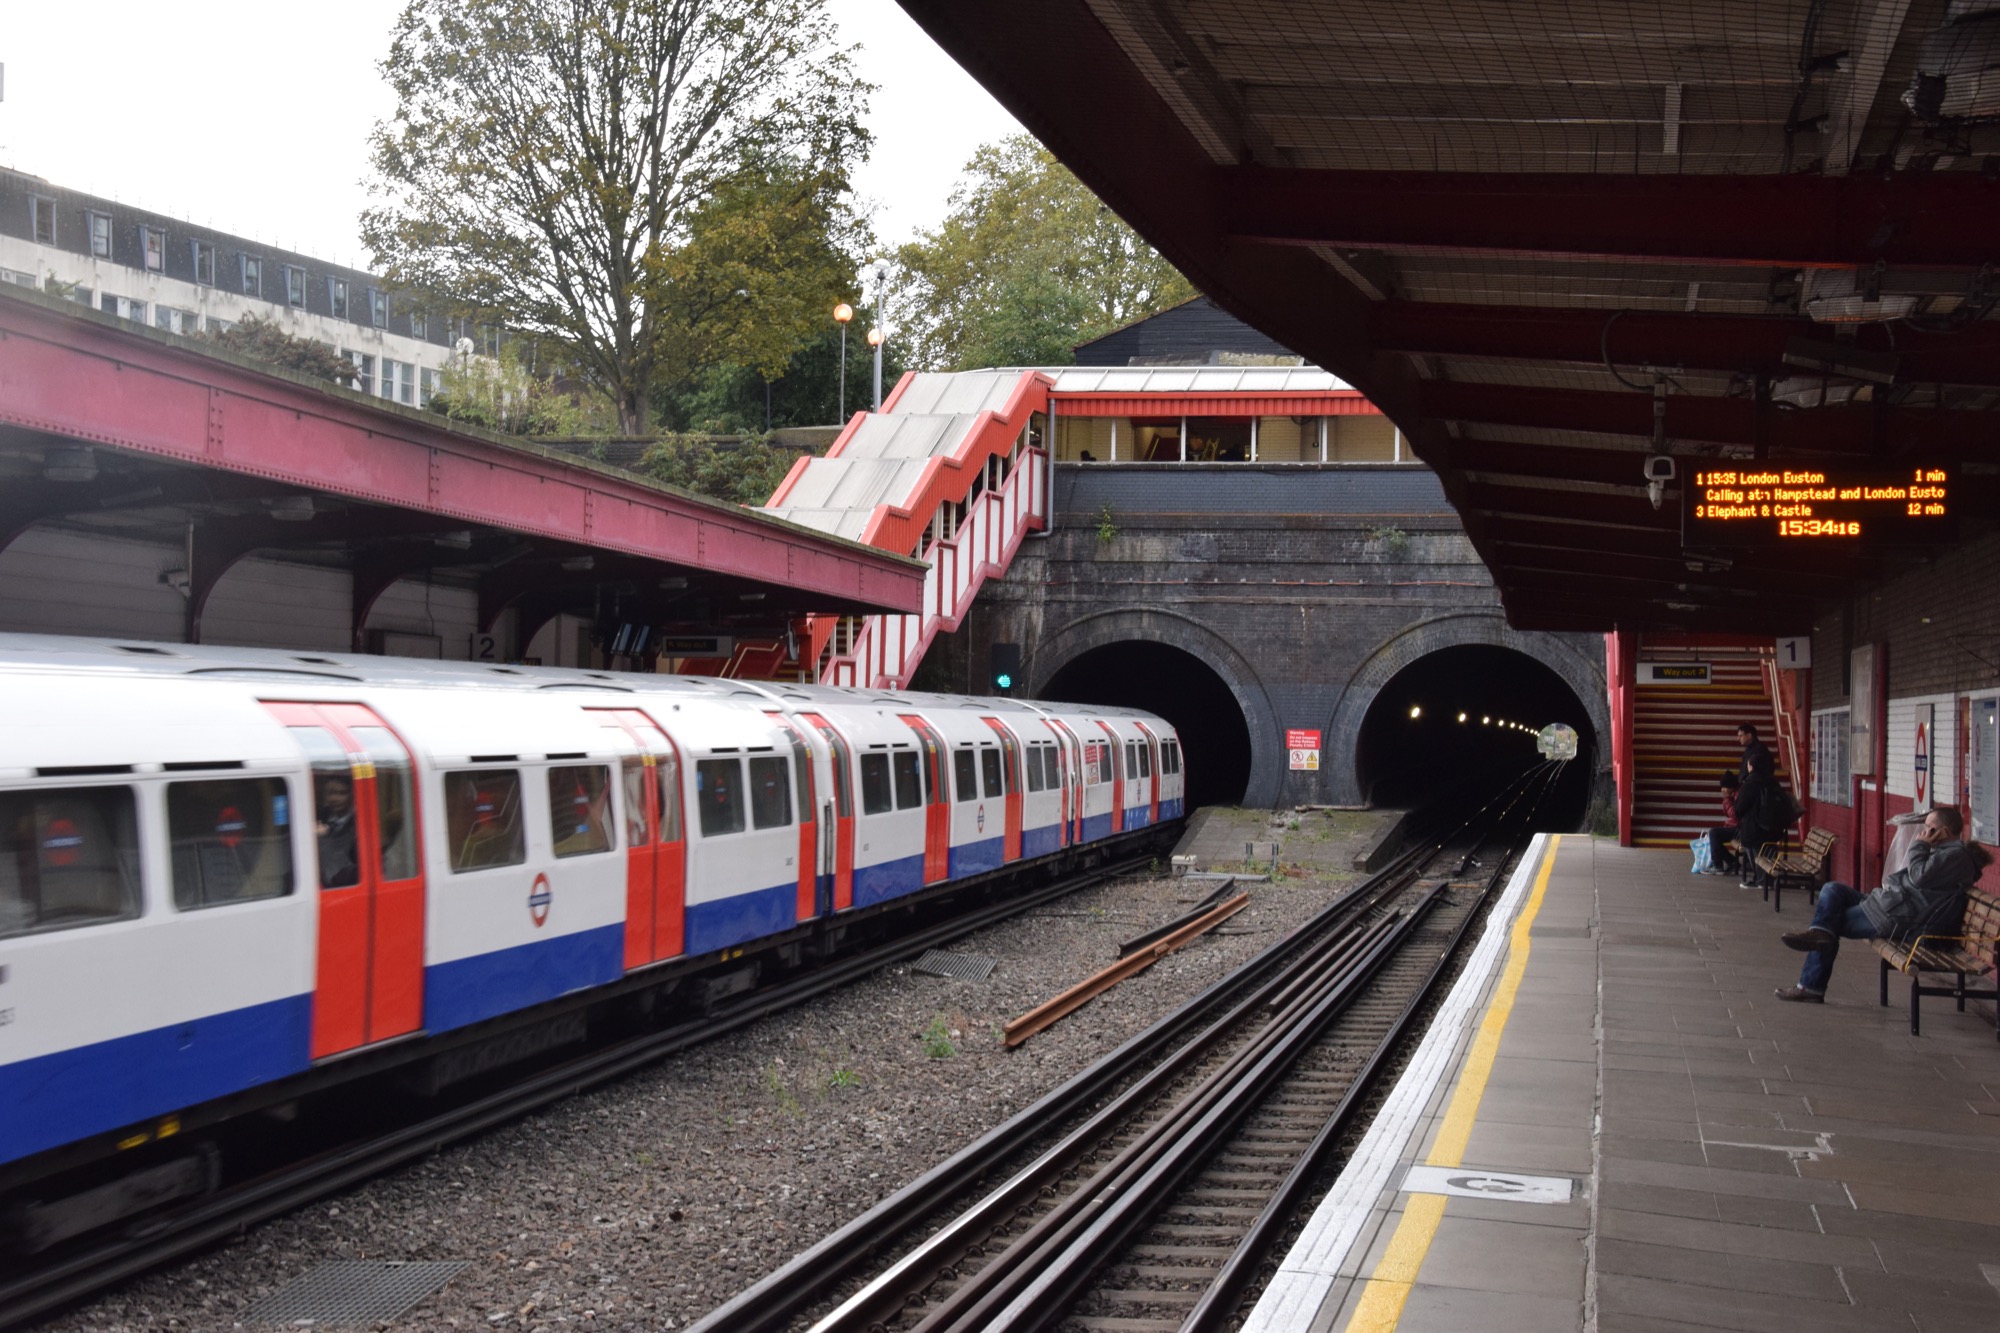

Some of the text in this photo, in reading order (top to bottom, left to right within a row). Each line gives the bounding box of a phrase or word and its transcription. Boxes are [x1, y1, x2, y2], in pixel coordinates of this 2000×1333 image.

[1696, 469, 1946, 485] 1 15:35 London Euston 1 min
[1706, 489, 1744, 504] Calling
[1774, 487, 1836, 503] Hampstead
[1840, 486, 1861, 499] and
[1864, 486, 1906, 499] London
[1909, 486, 1946, 499] Eusto
[1696, 502, 1945, 520] 3 Elephant & Castle 12 min
[1780, 520, 1860, 536] 15:34:16
[480, 636, 495, 659] 2
[1785, 640, 1796, 662] 1
[1663, 668, 1697, 677] Way out
